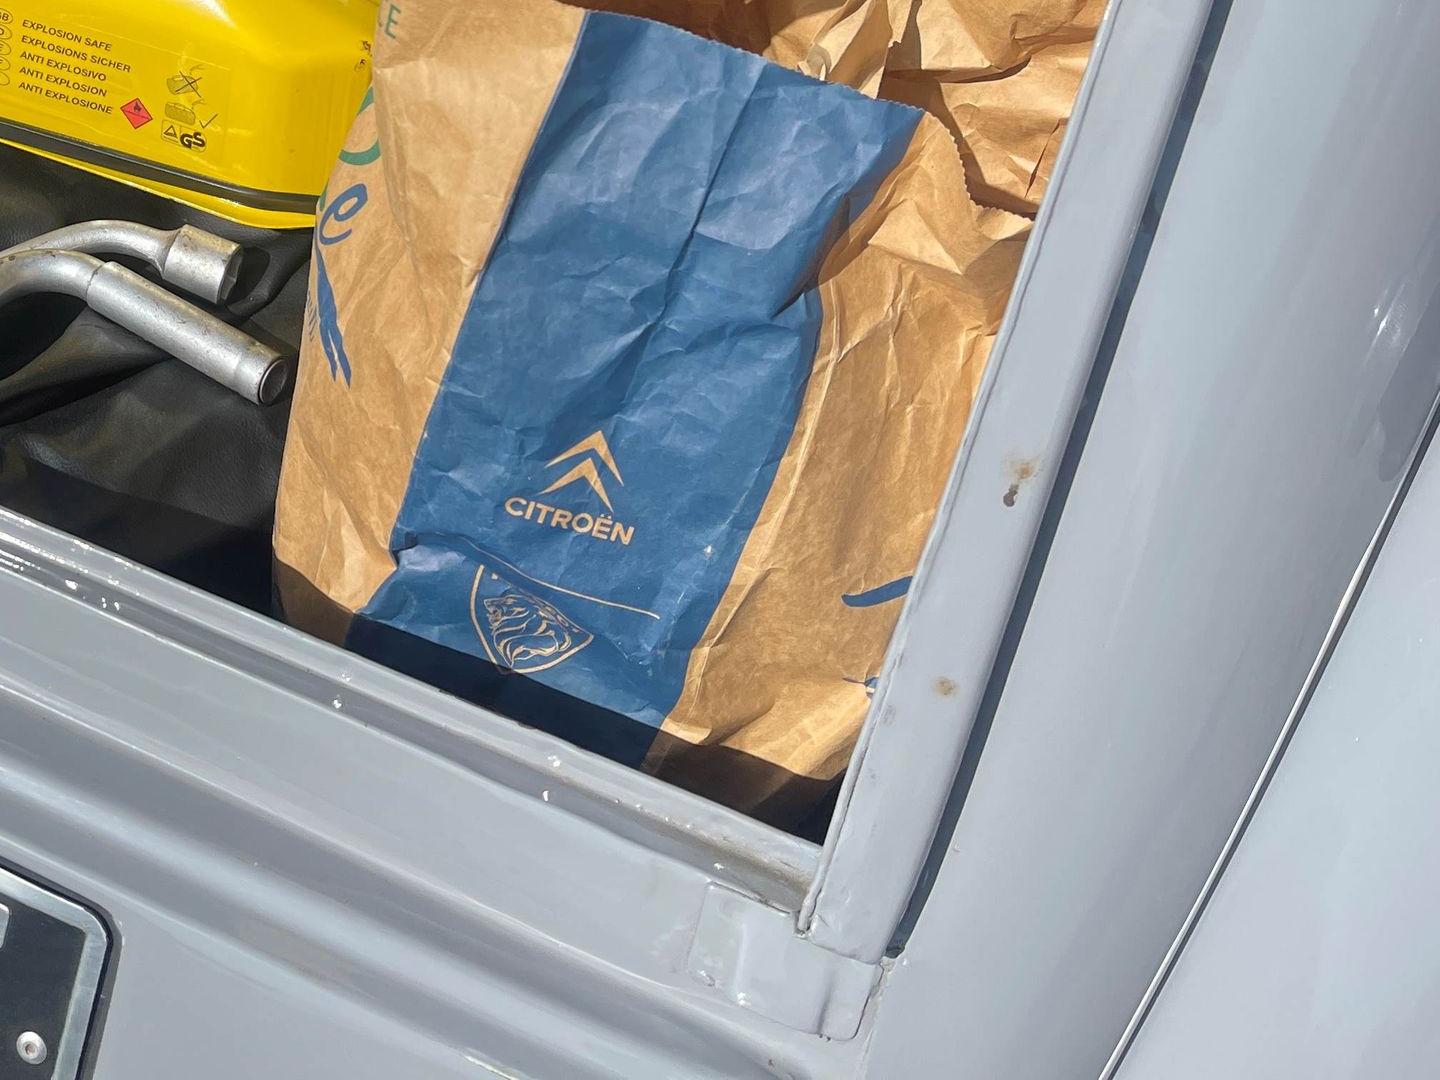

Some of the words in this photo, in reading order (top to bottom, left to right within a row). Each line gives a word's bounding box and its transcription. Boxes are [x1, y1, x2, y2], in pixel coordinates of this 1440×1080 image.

[22, 19, 82, 44] EXPLOSION
[84, 36, 112, 52] SAFE
[19, 51, 44, 65] ANTI
[46, 58, 107, 82] EXPLOSIVO
[21, 35, 88, 62] EXPLOSIONS
[90, 54, 131, 73] SICHER
[18, 81, 43, 96] ANTI
[45, 88, 113, 115] EXPLOSIONE
[19, 66, 44, 81] ANTI
[46, 74, 108, 97] EXPLOSION
[179, 131, 207, 150] GS
[504, 496, 635, 546] CITROËN
